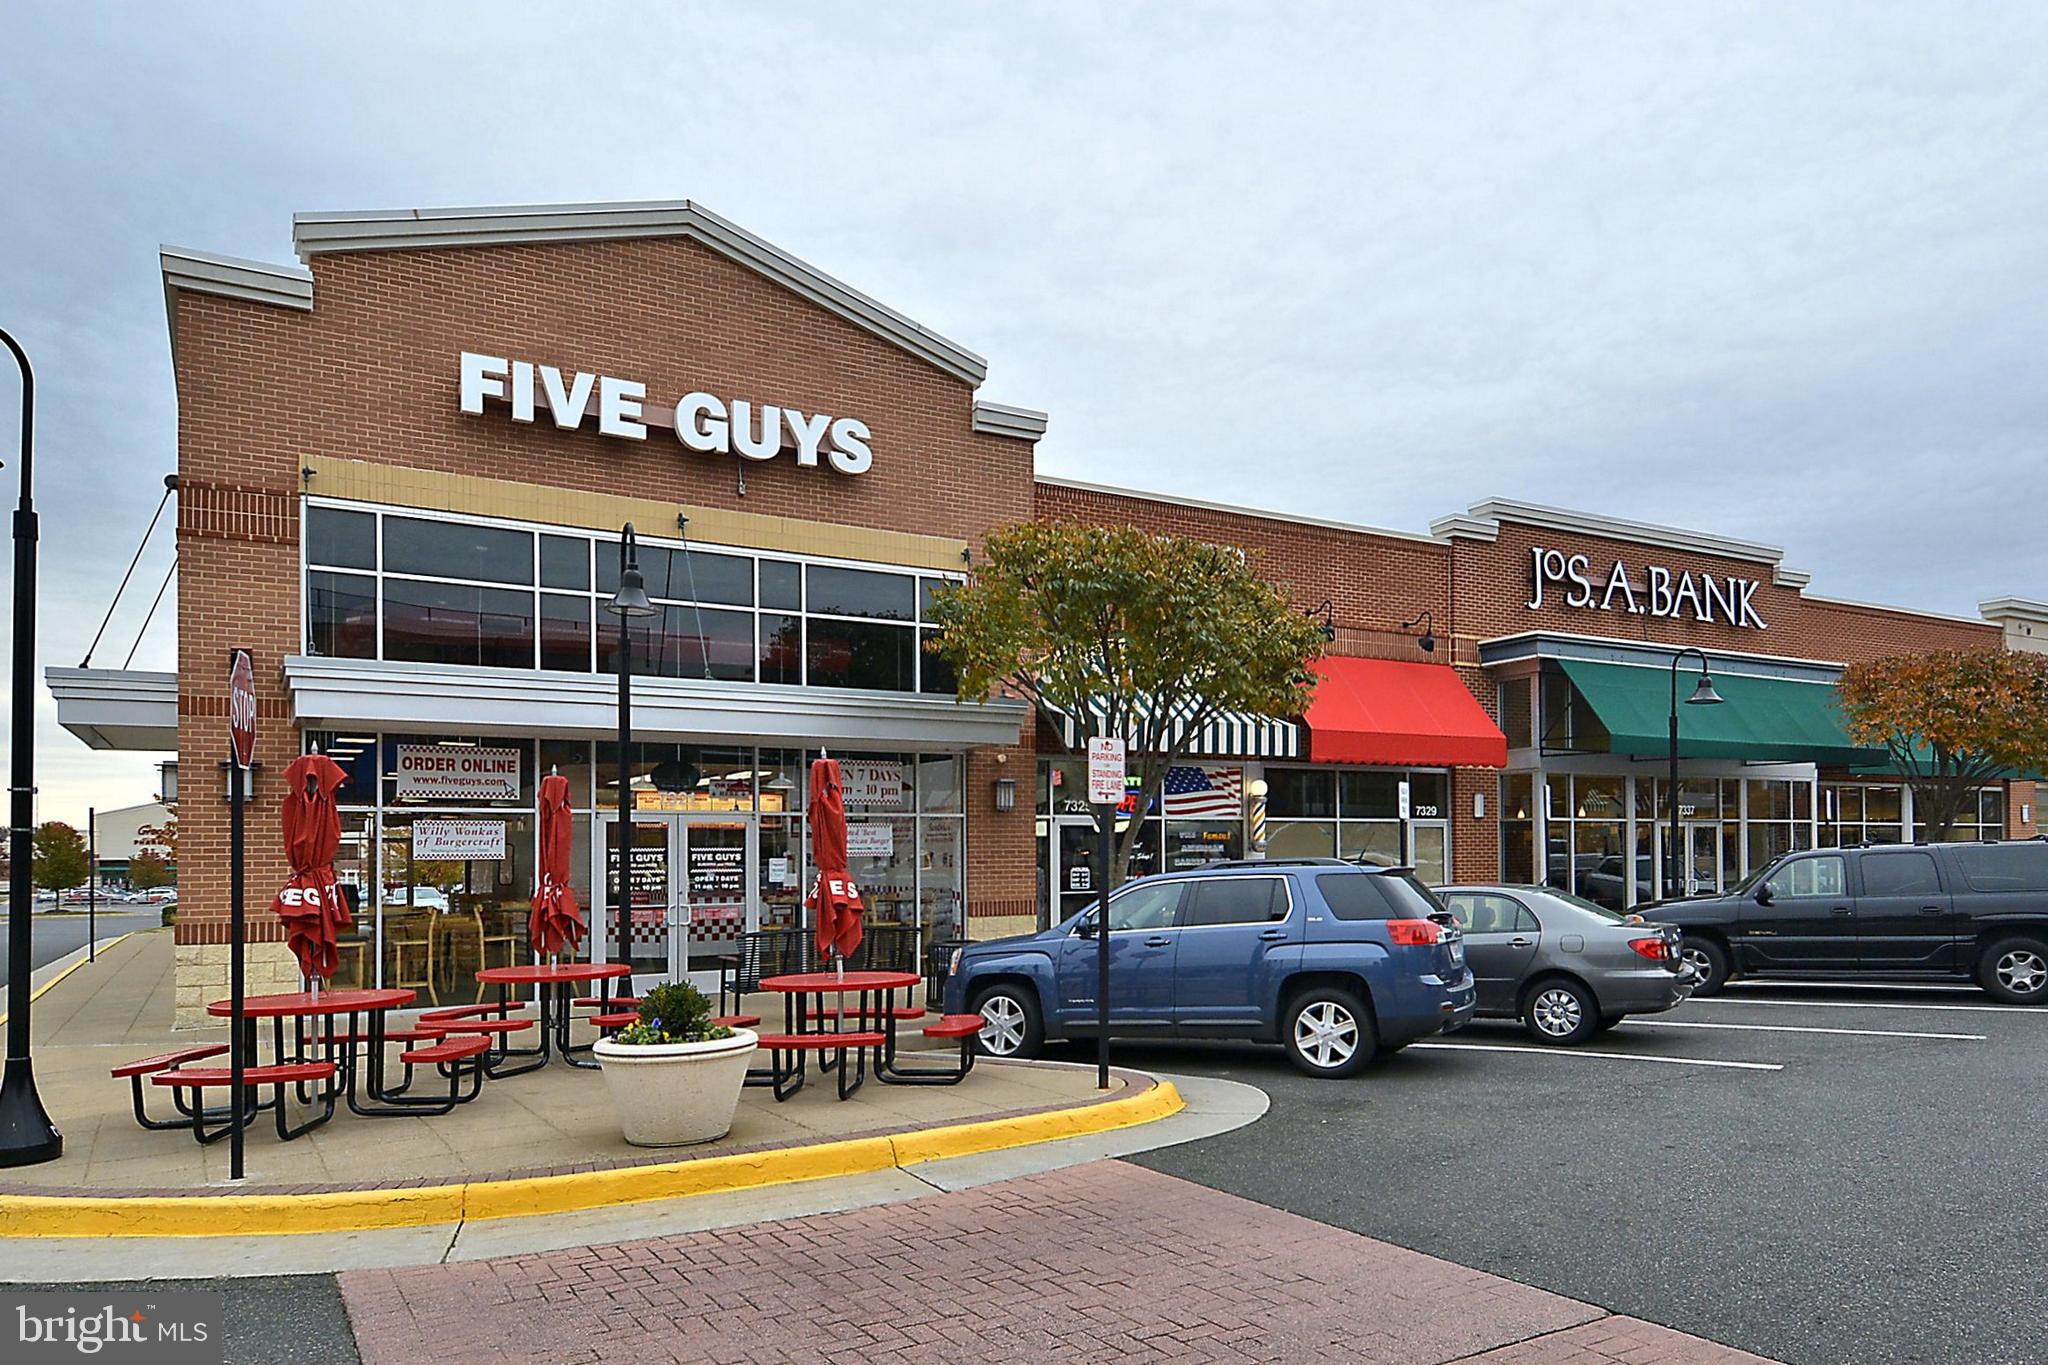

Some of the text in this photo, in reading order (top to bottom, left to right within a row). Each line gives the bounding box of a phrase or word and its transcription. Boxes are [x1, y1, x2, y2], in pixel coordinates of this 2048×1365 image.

[460, 351, 873, 475] FIVE GUYS
[1649, 566, 1768, 629] BANK
[232, 686, 256, 733] STOP
[1100, 743, 1113, 751] NO
[1092, 752, 1122, 761] PARKING
[402, 756, 516, 773] ORDER ONLINE
[858, 768, 865, 780] 7
[870, 769, 901, 781] DAYS
[1092, 769, 1122, 778] STANDING
[413, 775, 505, 786] www.fiveguys.com
[1092, 780, 1122, 790] FIRE LANE
[866, 784, 877, 795] 10
[881, 787, 898, 798] pm
[1416, 805, 1437, 816] 7329
[1678, 805, 1695, 815] 7337
[416, 837, 430, 848] of
[636, 854, 663, 862] GUYS
[691, 853, 742, 861] FIVE GUYS
